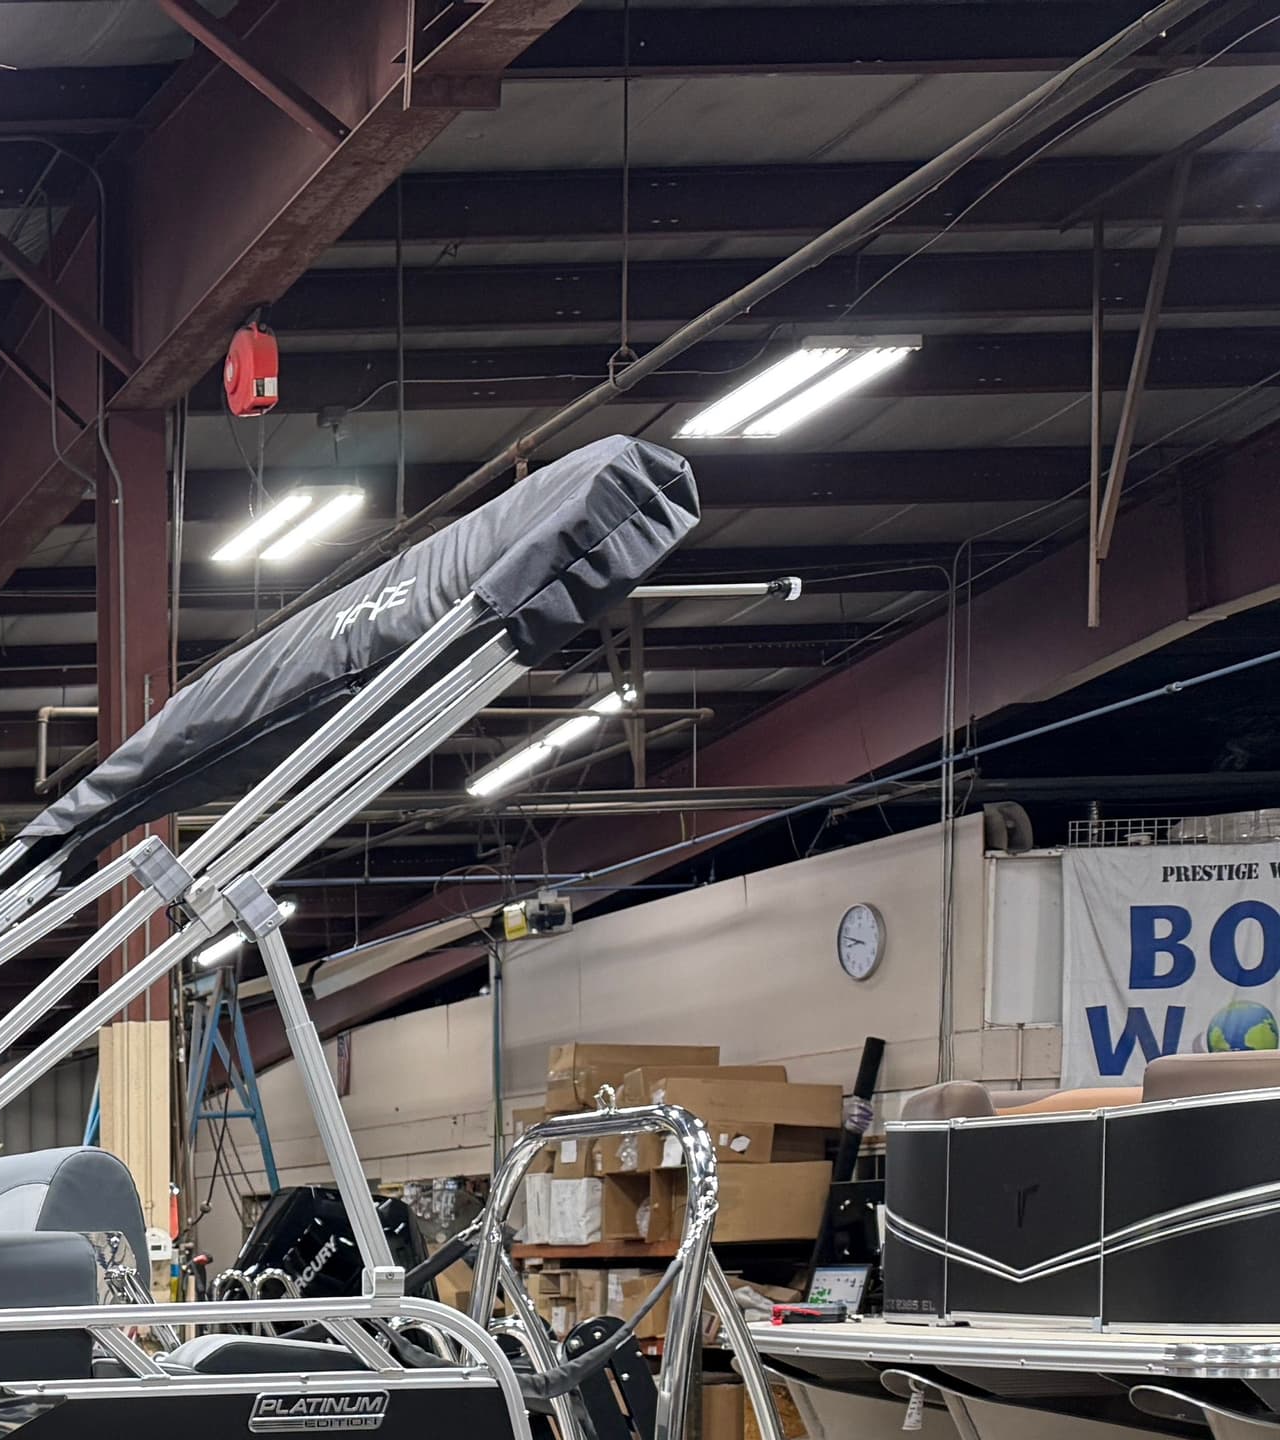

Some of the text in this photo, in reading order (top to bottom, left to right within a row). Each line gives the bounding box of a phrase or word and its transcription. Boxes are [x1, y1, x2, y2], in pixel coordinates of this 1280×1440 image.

[1162, 863, 1259, 882] PRESTIGE
[294, 1234, 336, 1293] RCURY
[259, 1396, 384, 1415] PLATINUM
[304, 1418, 378, 1428] EDITION
